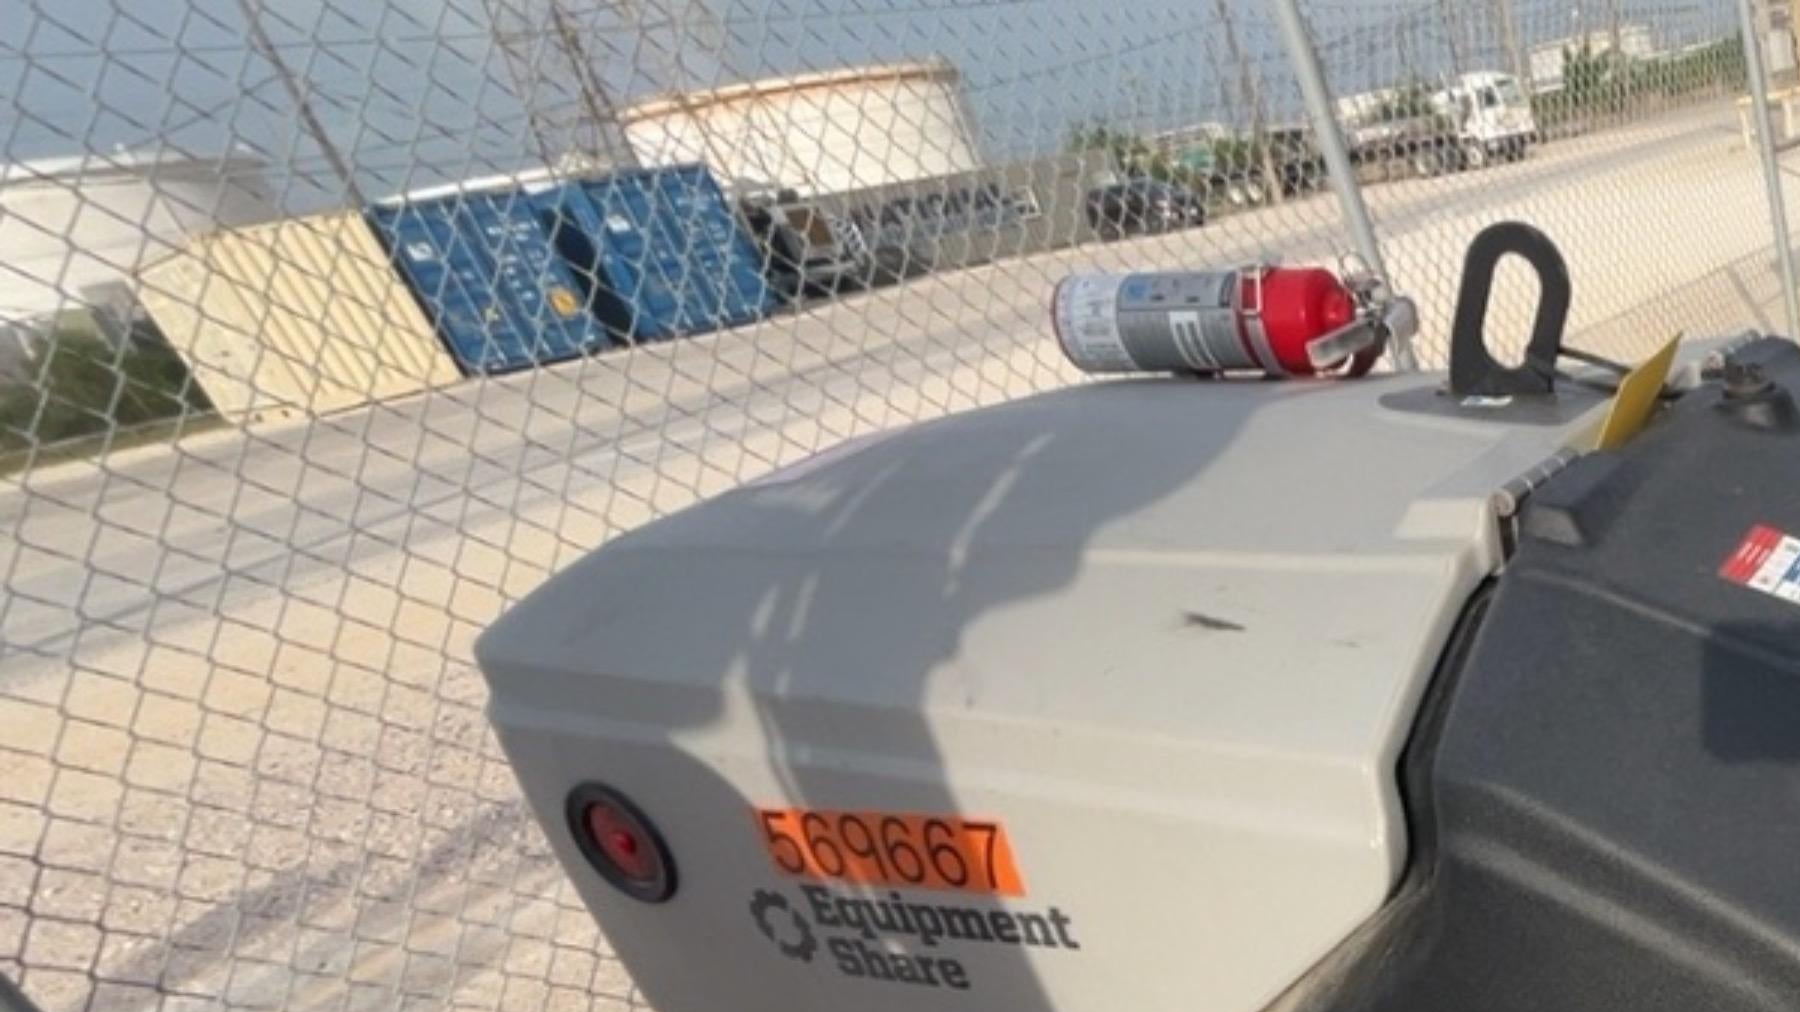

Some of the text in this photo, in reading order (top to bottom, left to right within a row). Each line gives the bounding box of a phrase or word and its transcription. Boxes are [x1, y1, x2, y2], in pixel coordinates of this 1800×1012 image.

[761, 810, 998, 889] 569667
[802, 884, 1081, 951] Equipment
[826, 936, 972, 990] Share
